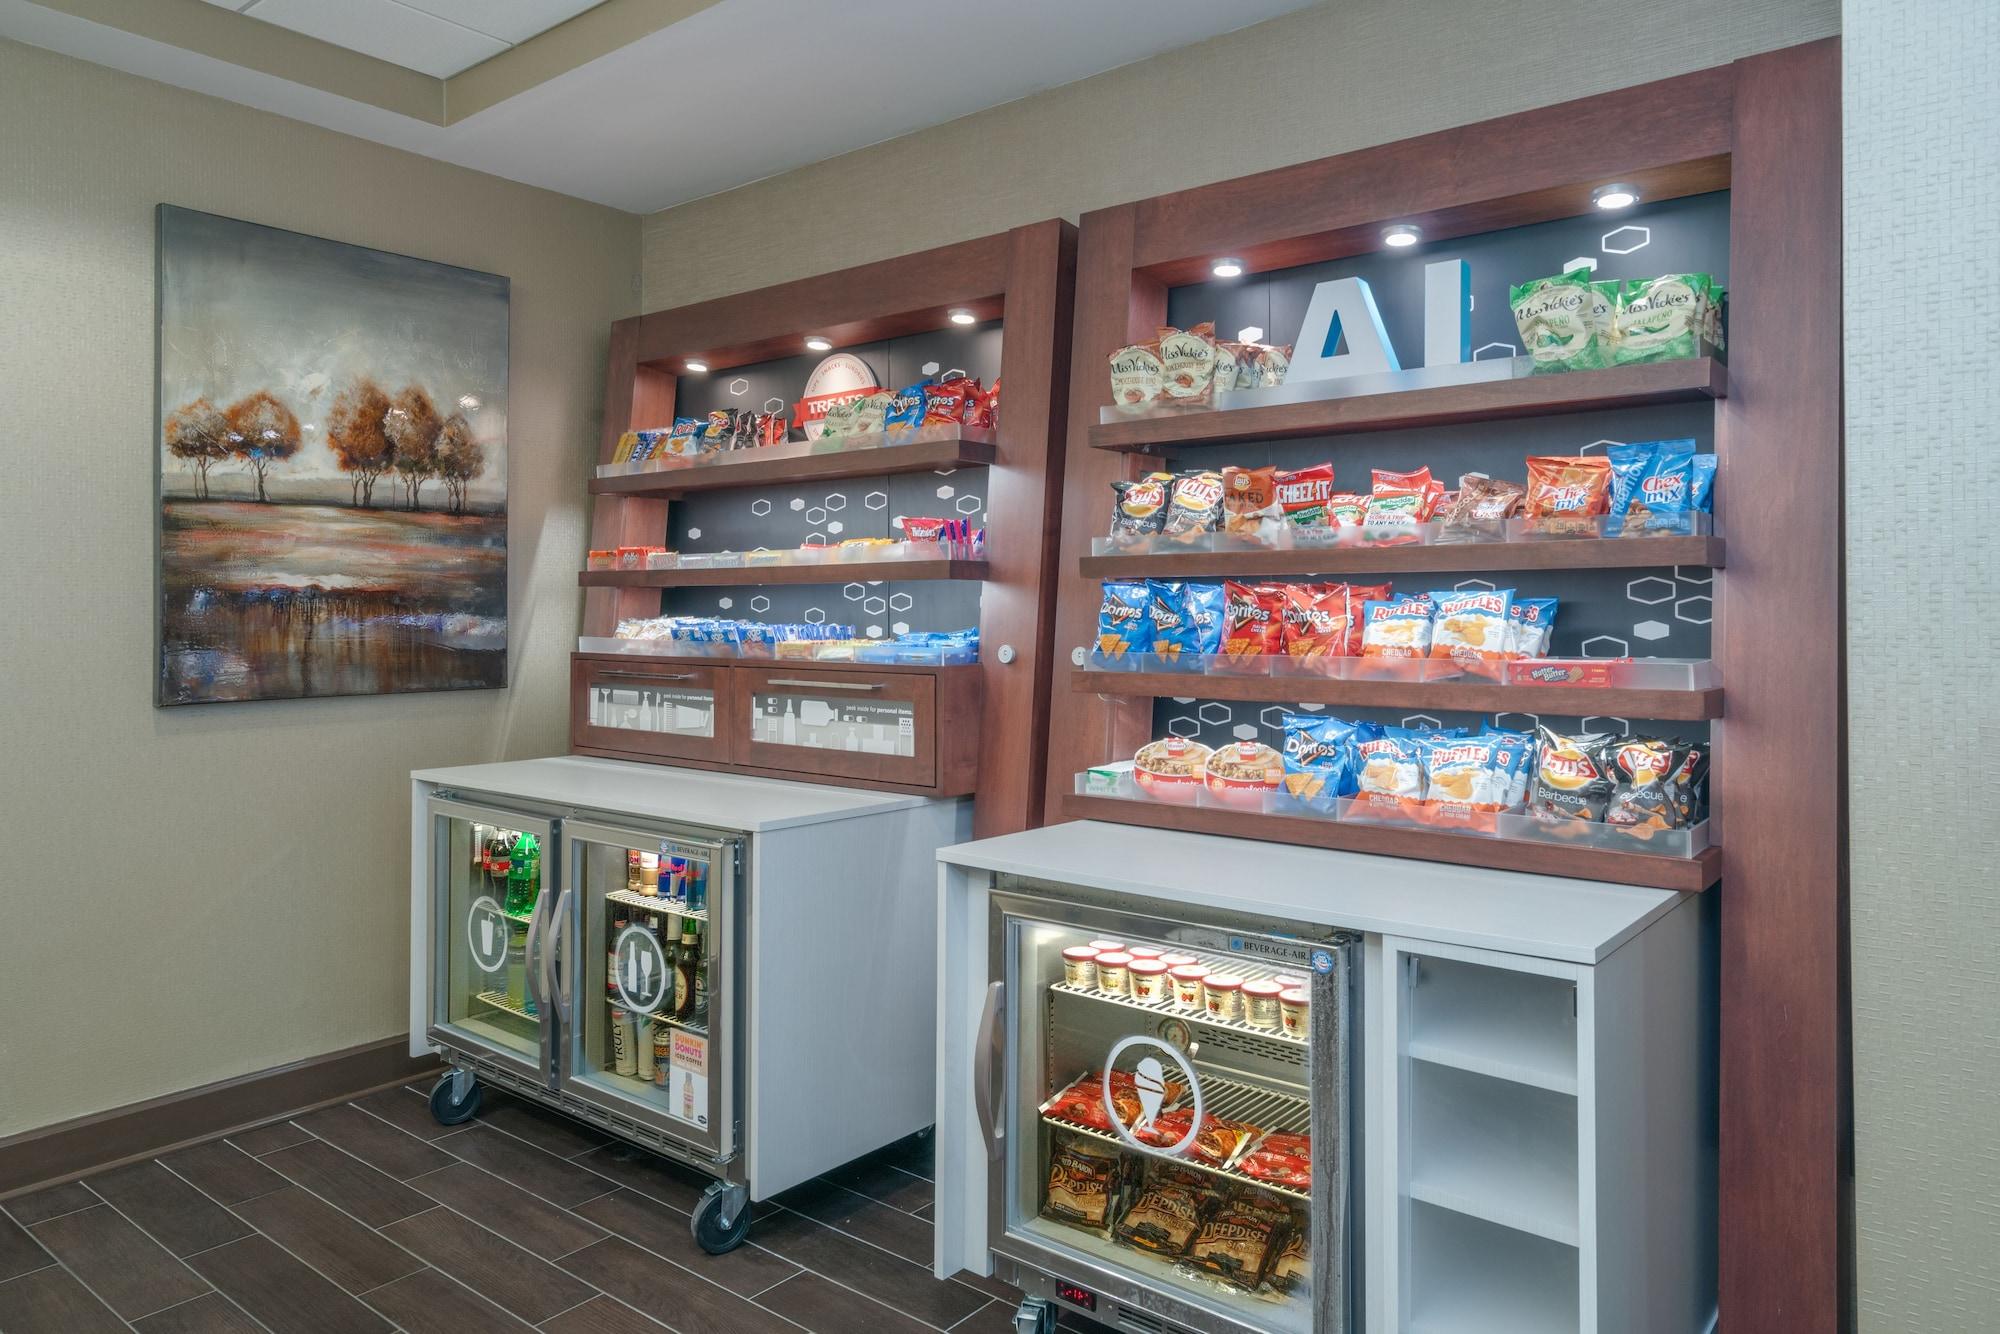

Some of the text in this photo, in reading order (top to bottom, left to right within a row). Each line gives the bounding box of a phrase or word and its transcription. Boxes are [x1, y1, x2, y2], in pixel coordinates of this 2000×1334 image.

[1647, 290, 1691, 309] Vickie's
[1176, 341, 1208, 360] Vickie's
[1642, 471, 1686, 493] Chex
[1100, 602, 1143, 620] Doritos
[1373, 603, 1430, 620] RUFFLES
[1441, 597, 1503, 614] RUFFLES
[1382, 648, 1412, 657] CHEDDAR
[1450, 648, 1483, 660] CHEDDAR
[1532, 666, 1555, 679] Nutter
[1544, 669, 1567, 681] Butter
[1287, 738, 1336, 759] Doritos
[1432, 747, 1490, 767] RUFFLES
[1538, 787, 1588, 805] Barbecue
[614, 1023, 623, 1061] TRULY
[675, 1042, 703, 1059] DONUTS
[685, 1056, 703, 1067] COFFEE
[1071, 1160, 1093, 1176] BARON
